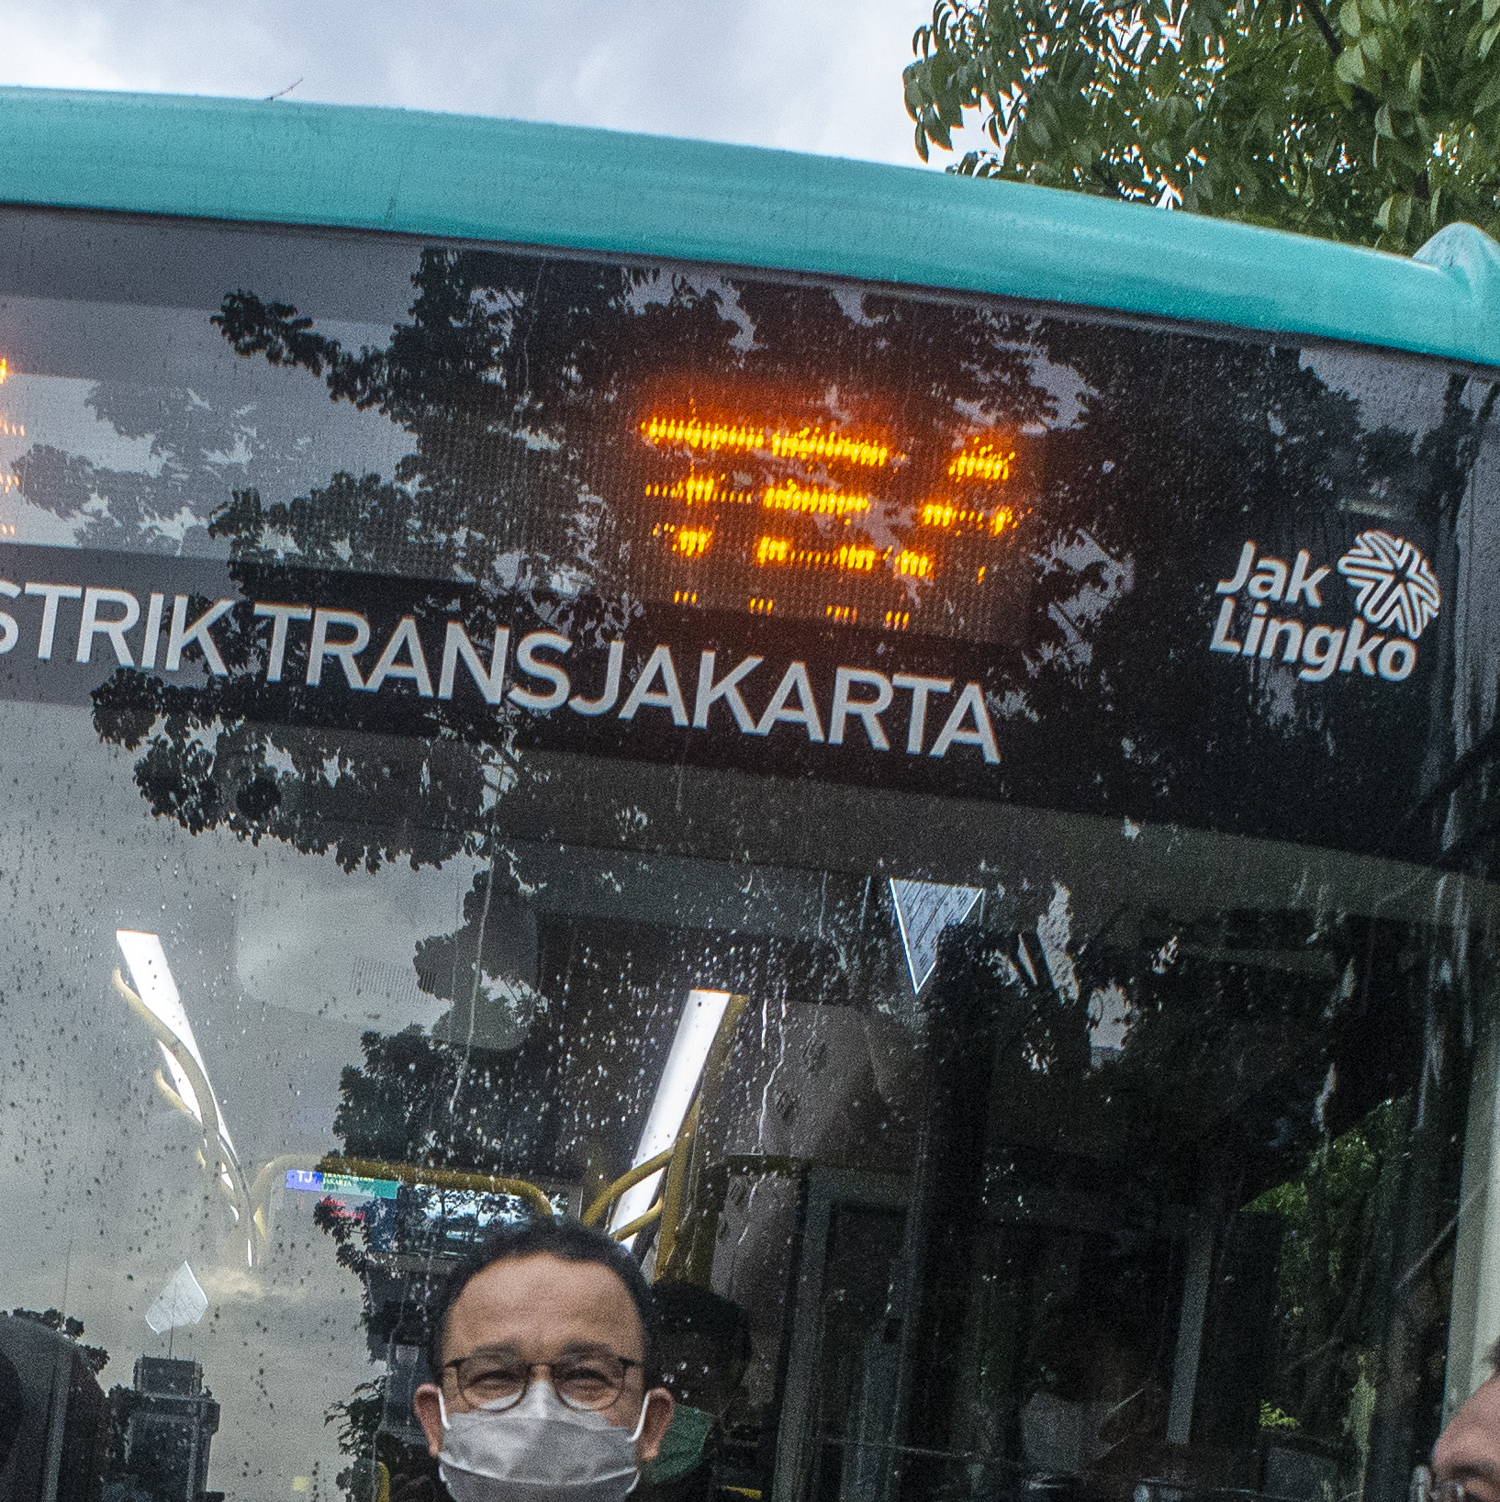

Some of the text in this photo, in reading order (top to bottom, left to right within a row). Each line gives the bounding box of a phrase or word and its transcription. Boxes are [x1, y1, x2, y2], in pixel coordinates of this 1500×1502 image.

[1215, 539, 1331, 608] Jak
[1209, 596, 1417, 682] Lingko
[252, 602, 1001, 765] TRANSJAKARTA
